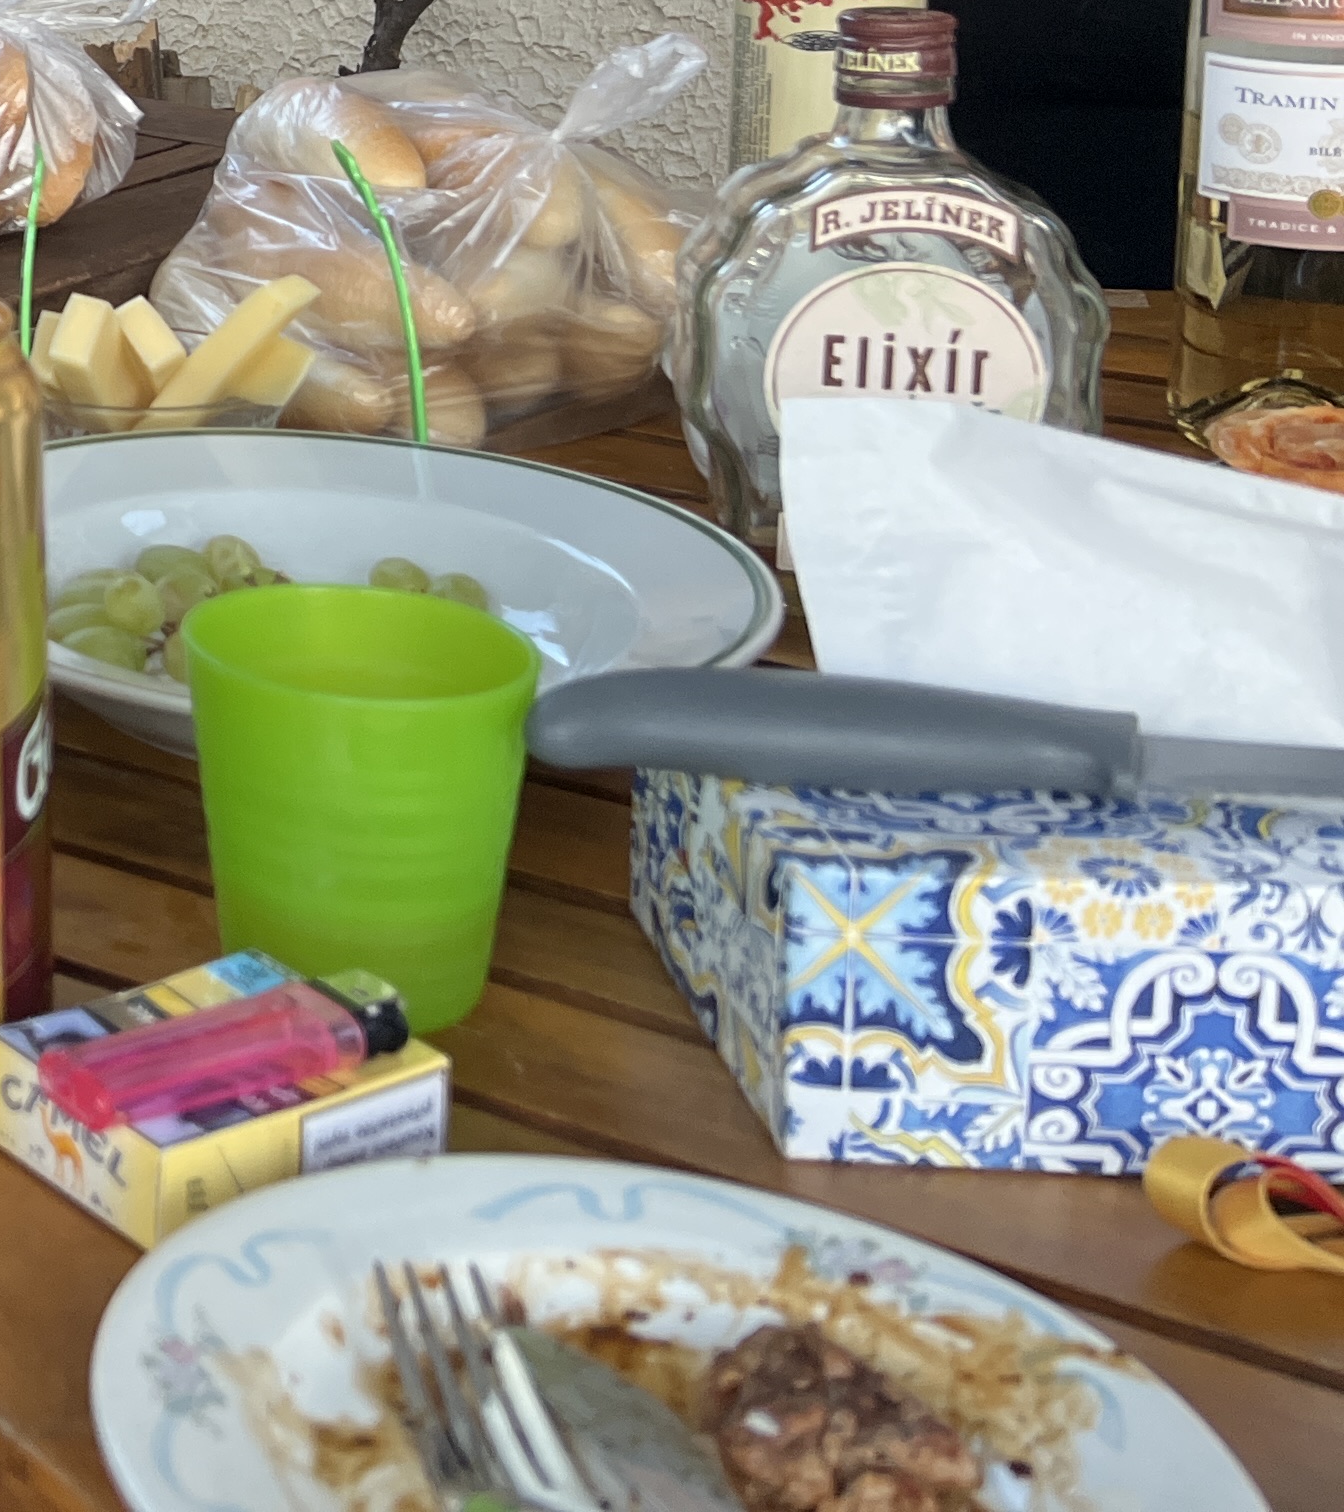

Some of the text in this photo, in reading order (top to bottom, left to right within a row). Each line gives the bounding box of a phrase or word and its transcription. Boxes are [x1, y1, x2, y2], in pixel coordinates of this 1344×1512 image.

[1235, 86, 1338, 110] TRAMIN
[821, 209, 851, 234] R.
[1248, 218, 1319, 233] TRADICE
[821, 328, 991, 396] Elixír
